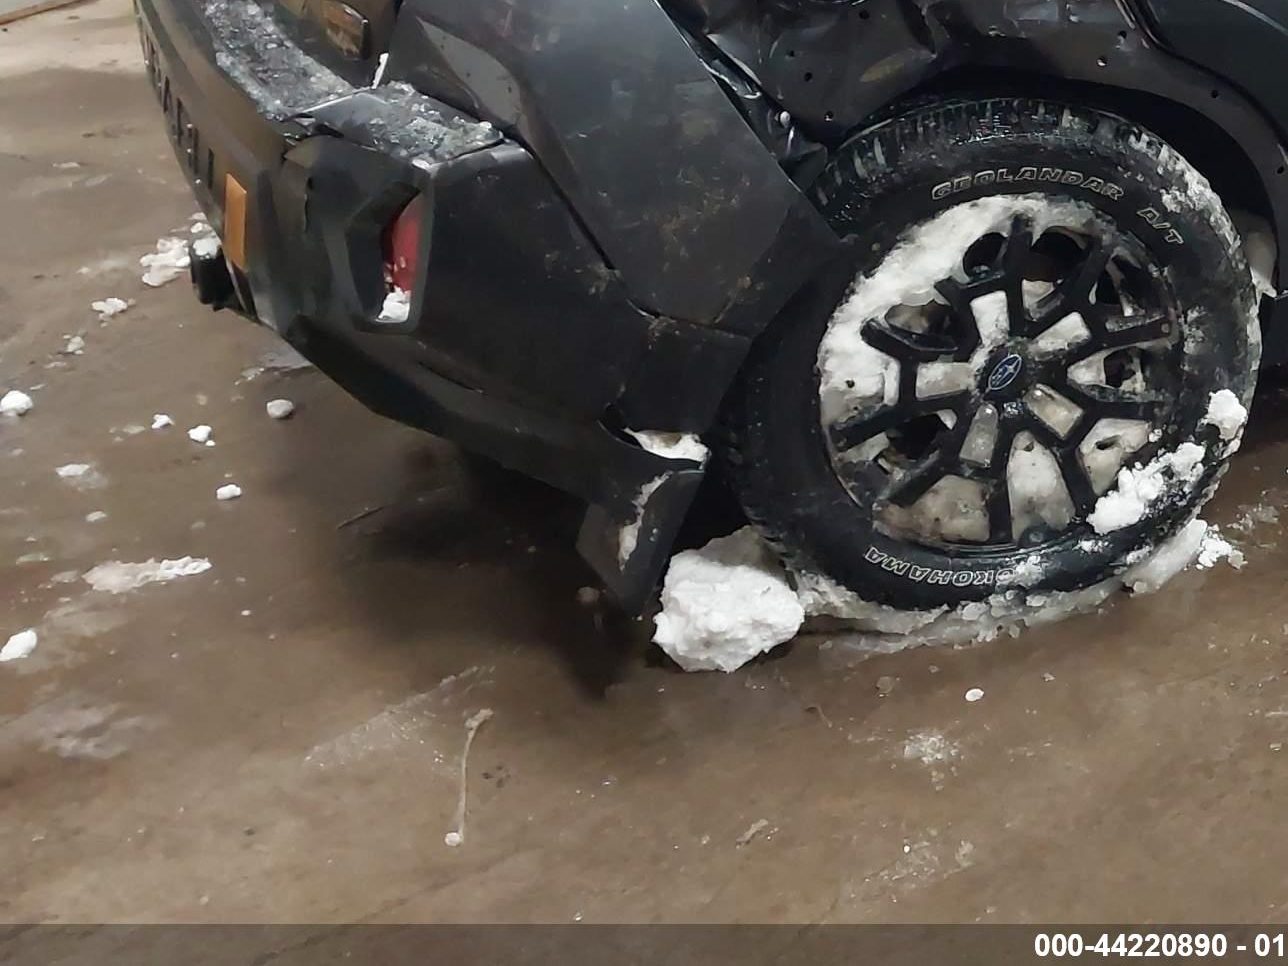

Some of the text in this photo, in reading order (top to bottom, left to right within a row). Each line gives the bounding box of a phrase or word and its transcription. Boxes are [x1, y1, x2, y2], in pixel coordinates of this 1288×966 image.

[931, 166, 1184, 244] GEOLANDAR A/T
[864, 546, 1016, 586] OKOHAMA
